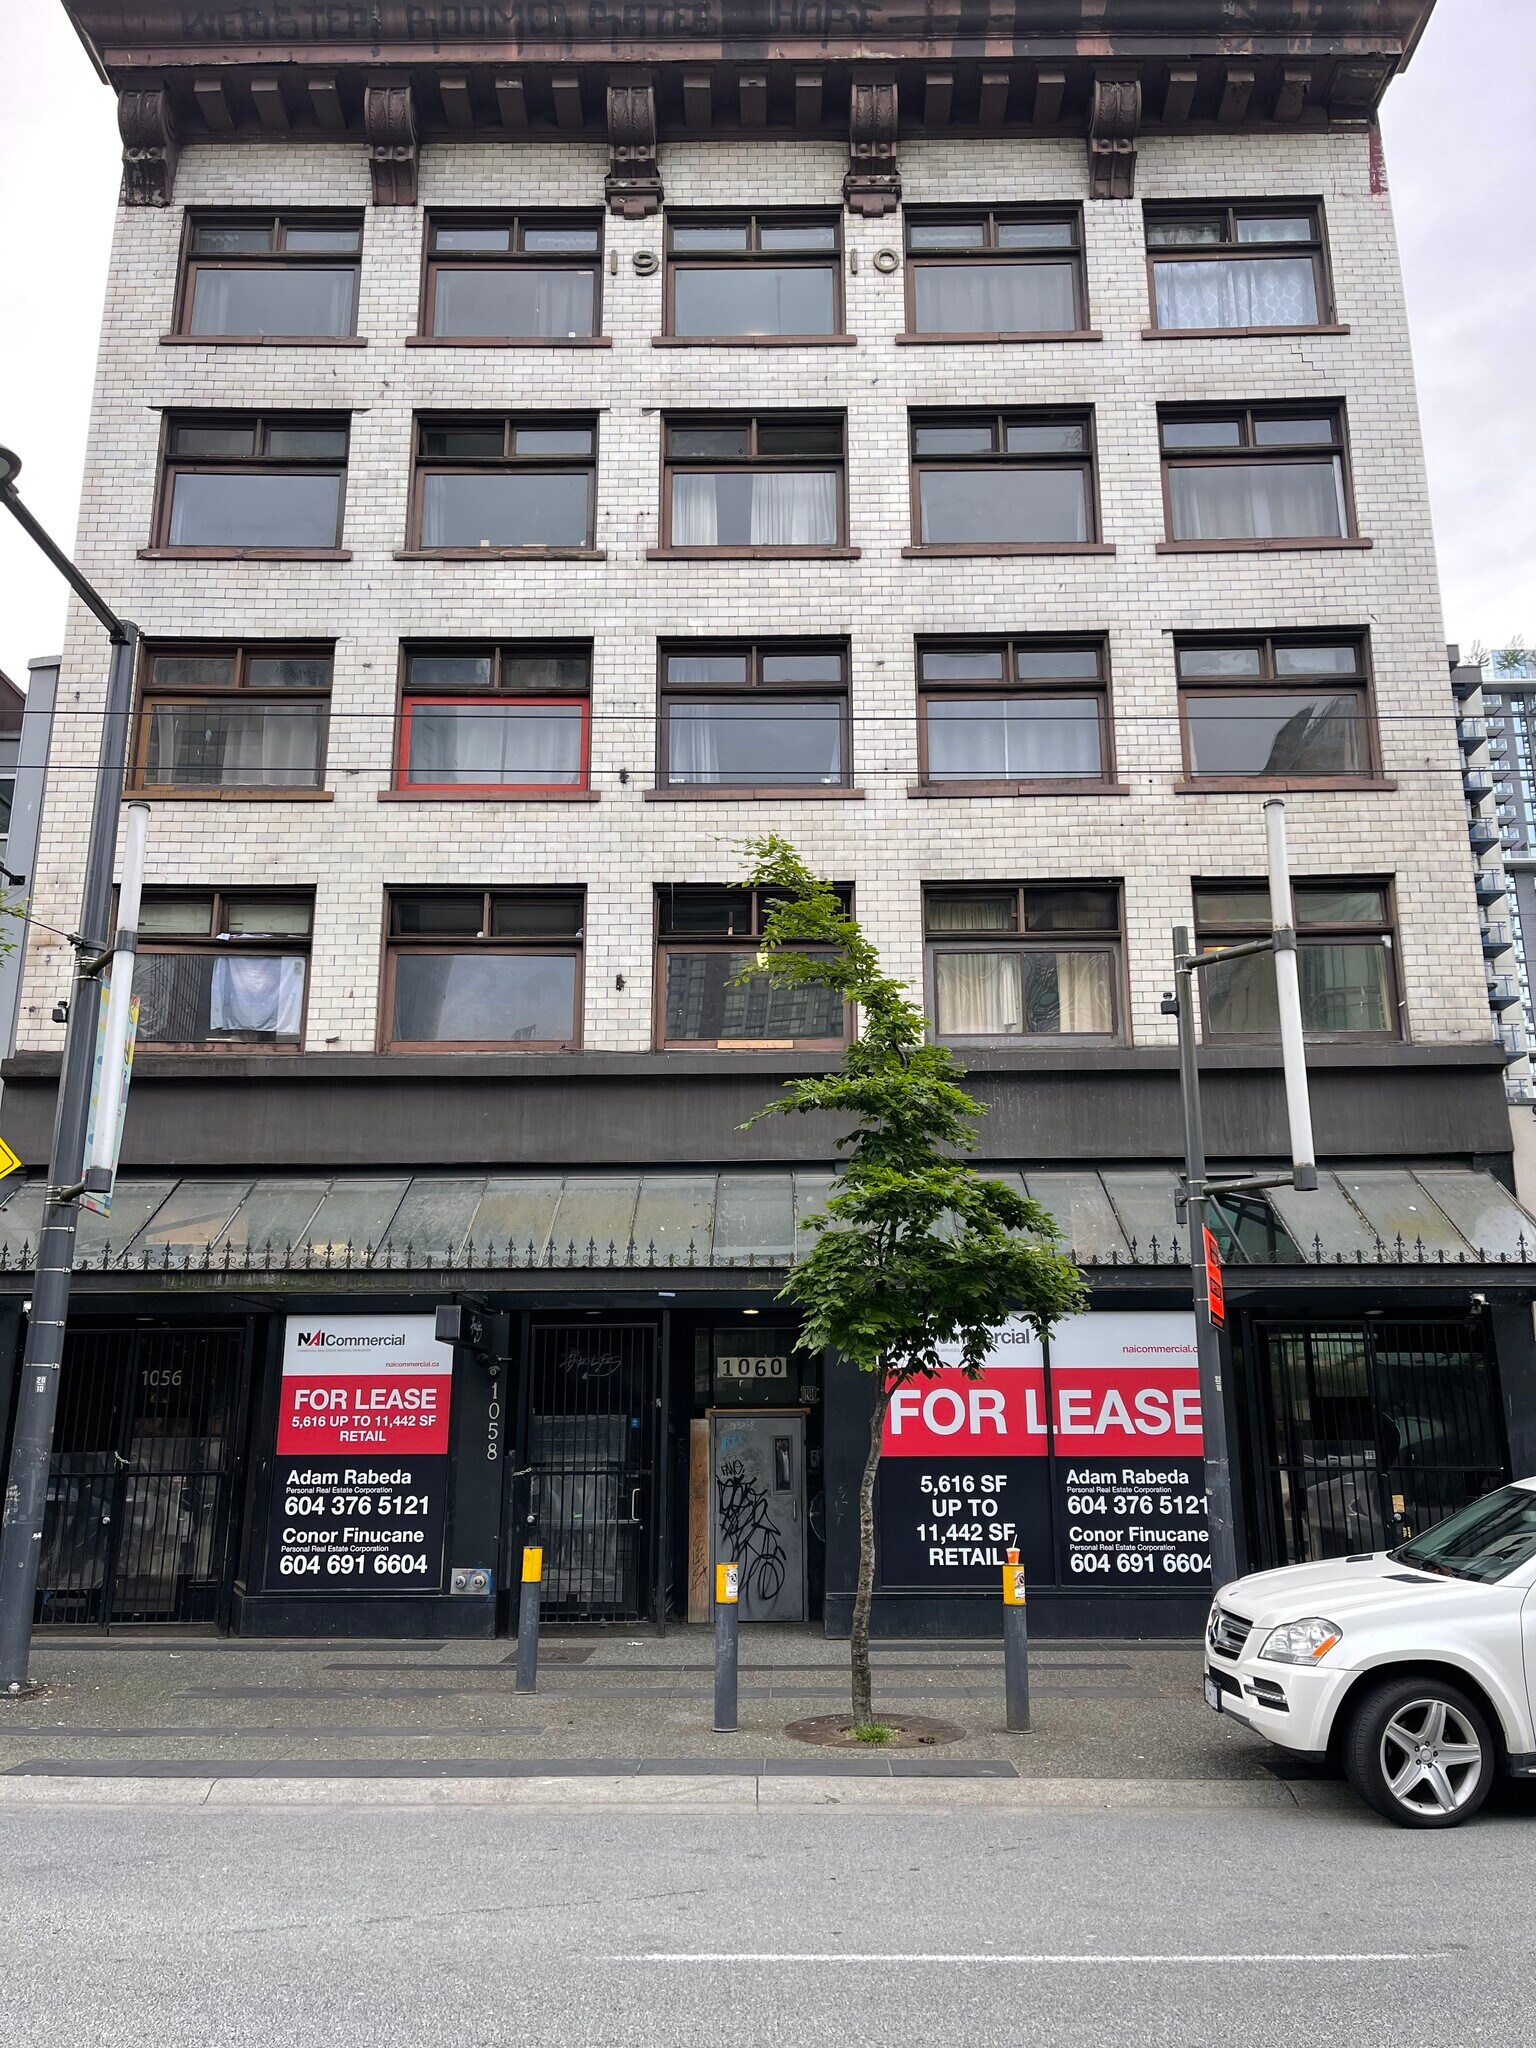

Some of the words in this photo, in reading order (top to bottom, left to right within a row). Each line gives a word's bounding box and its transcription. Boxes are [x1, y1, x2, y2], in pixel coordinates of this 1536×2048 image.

[1122, 1344, 1199, 1353] naicommercial.c
[722, 1358, 782, 1377] 1060
[141, 1370, 182, 1386] 1056
[294, 1389, 348, 1410] FOR
[355, 1388, 438, 1410] LEASE
[890, 1388, 1008, 1435] FOR
[1026, 1388, 1203, 1435] LEASE
[291, 1416, 326, 1429] 5,616
[330, 1416, 349, 1427] UP
[352, 1415, 371, 1427] TO
[375, 1415, 416, 1428] 11,442
[419, 1415, 437, 1426] SF
[486, 1382, 500, 1460] 1058
[339, 1430, 387, 1442] RETAIL
[286, 1469, 339, 1485] Adam
[344, 1469, 412, 1485] Rabeda
[920, 1475, 975, 1496] 5,616
[980, 1475, 1008, 1493] SF
[1066, 1469, 1117, 1485] Adam
[1122, 1469, 1189, 1485] Rabeda
[354, 1486, 393, 1495] Corporation
[1134, 1486, 1172, 1494] Corporation
[284, 1496, 325, 1515] 604
[331, 1496, 372, 1515] 376
[377, 1495, 429, 1515] 5121
[932, 1499, 962, 1517] UP
[967, 1498, 998, 1517] TO
[1067, 1496, 1107, 1515] 604
[1113, 1496, 1154, 1515] 376
[1159, 1496, 1209, 1515] 5121
[282, 1528, 339, 1543] Conor
[343, 1527, 425, 1543] Finucane
[916, 1523, 984, 1545] 11,442
[988, 1523, 1016, 1541] SF
[1069, 1527, 1124, 1542] Conor
[1128, 1527, 1210, 1542] Finucane
[350, 1545, 389, 1553] Corporation
[929, 1547, 1005, 1566] RETAIL
[1137, 1544, 1176, 1553] Corporation
[279, 1554, 320, 1574] 604
[326, 1554, 365, 1574] 691
[373, 1554, 428, 1574] 6604
[1070, 1553, 1111, 1573] 604
[1116, 1553, 1155, 1573] 691
[1163, 1553, 1212, 1573] 6604
